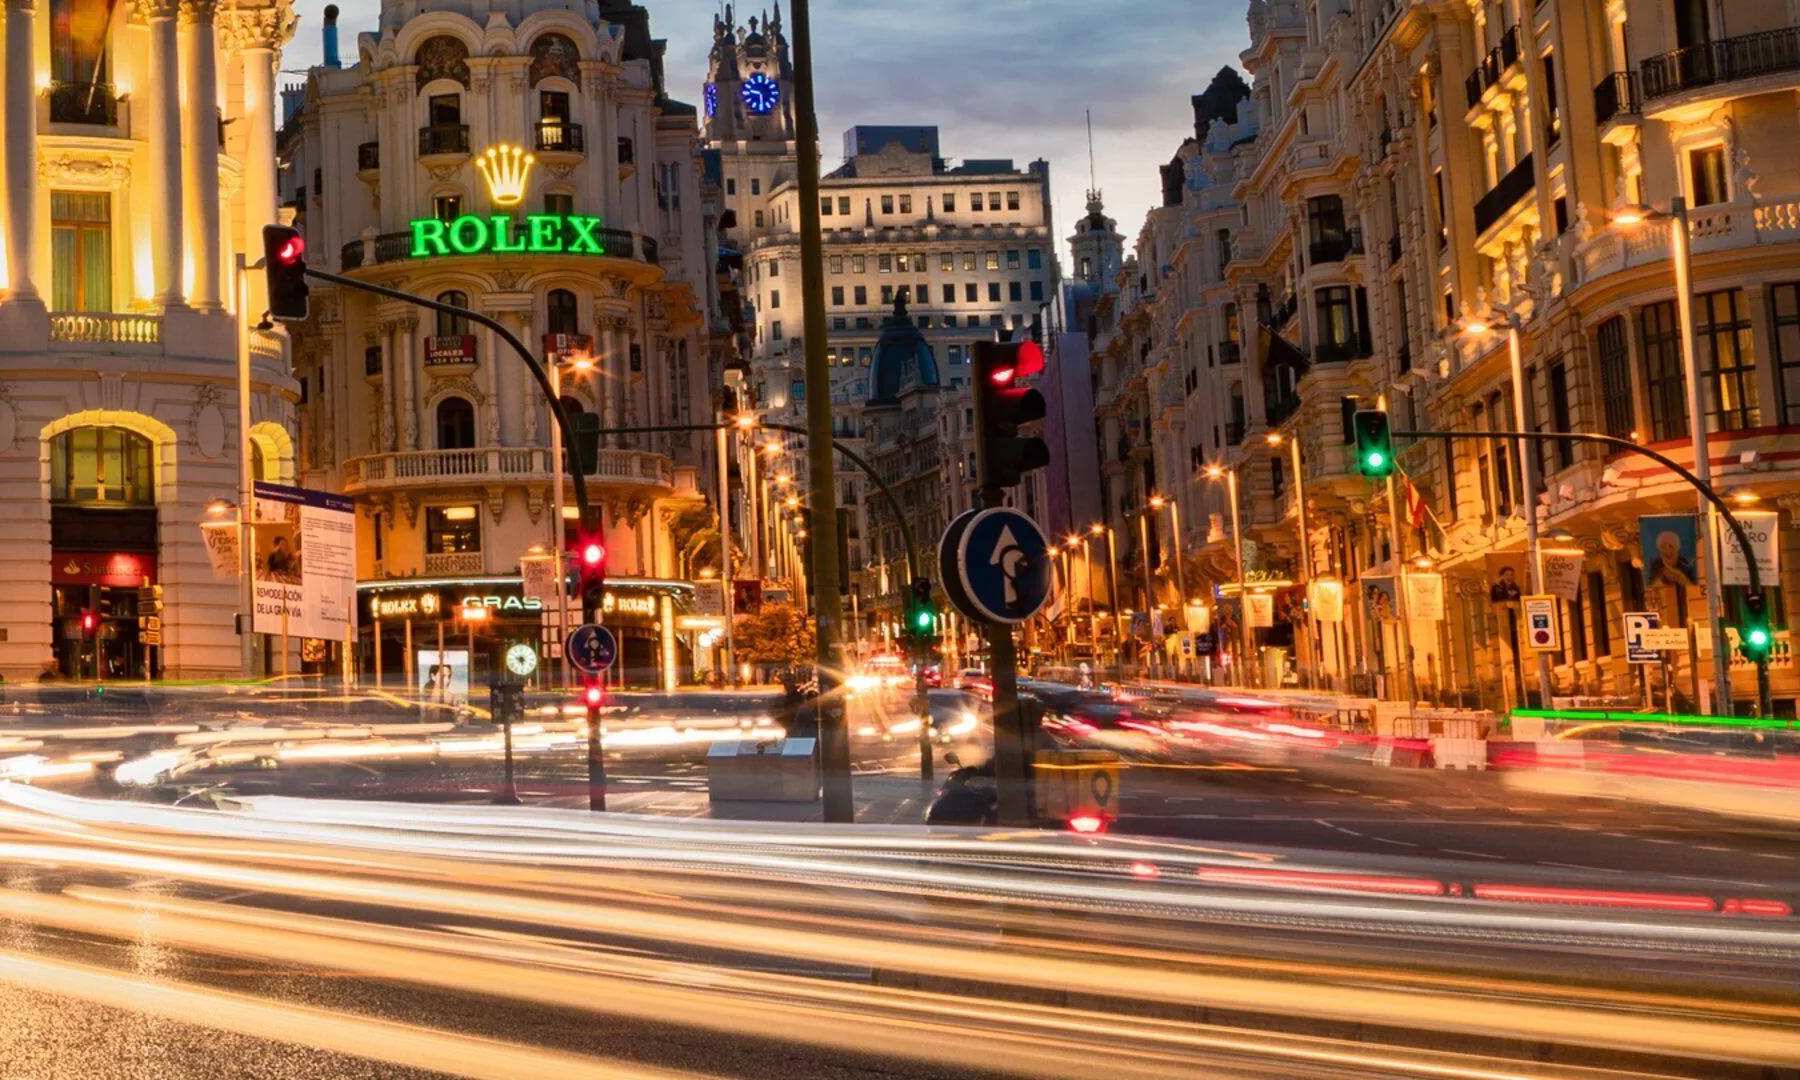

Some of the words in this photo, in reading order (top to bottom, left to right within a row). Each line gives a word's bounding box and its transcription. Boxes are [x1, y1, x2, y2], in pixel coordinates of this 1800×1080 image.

[410, 215, 604, 257] ROLEX
[83, 561, 145, 577] Santander
[257, 604, 265, 614] DE
[265, 604, 274, 615] LA
